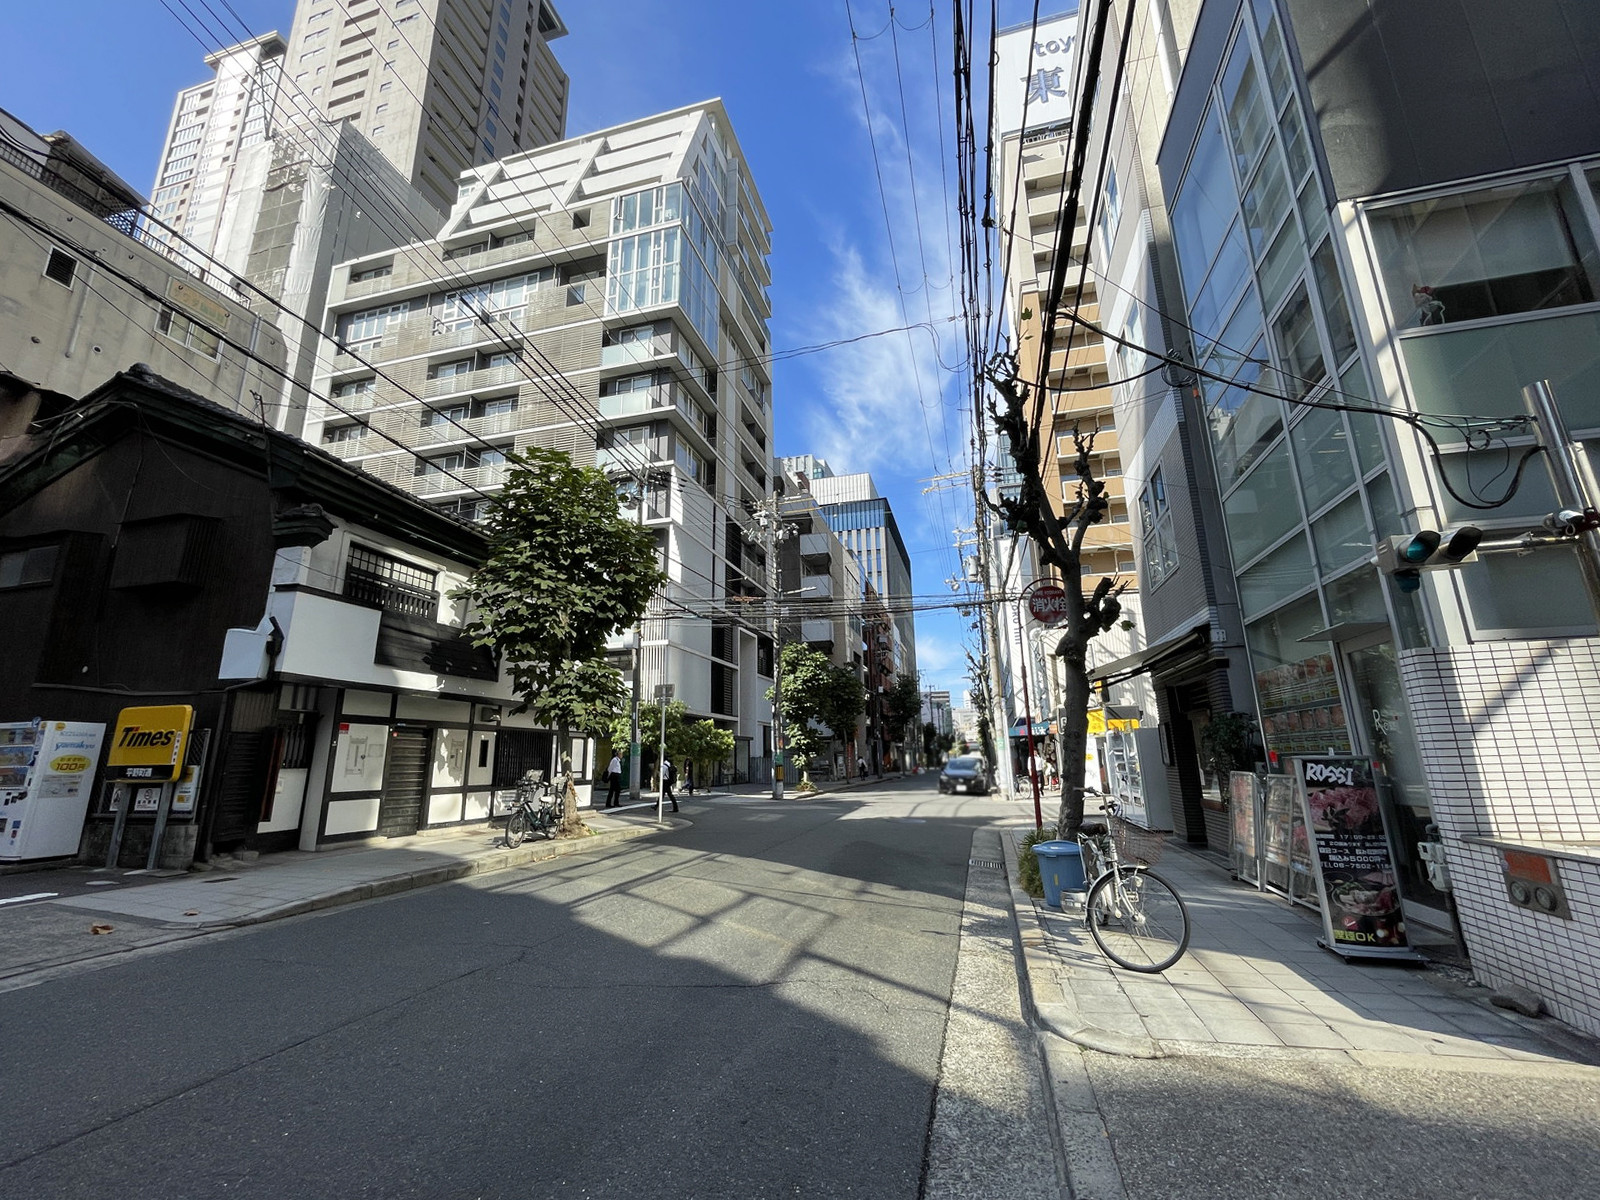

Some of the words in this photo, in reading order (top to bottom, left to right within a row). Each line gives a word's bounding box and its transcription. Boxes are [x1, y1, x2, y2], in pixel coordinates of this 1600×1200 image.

[1020, 66, 1067, 105] 東
[1033, 597, 1067, 613] 消火栓
[119, 726, 175, 747] Times
[1306, 763, 1354, 786] ROSSI
